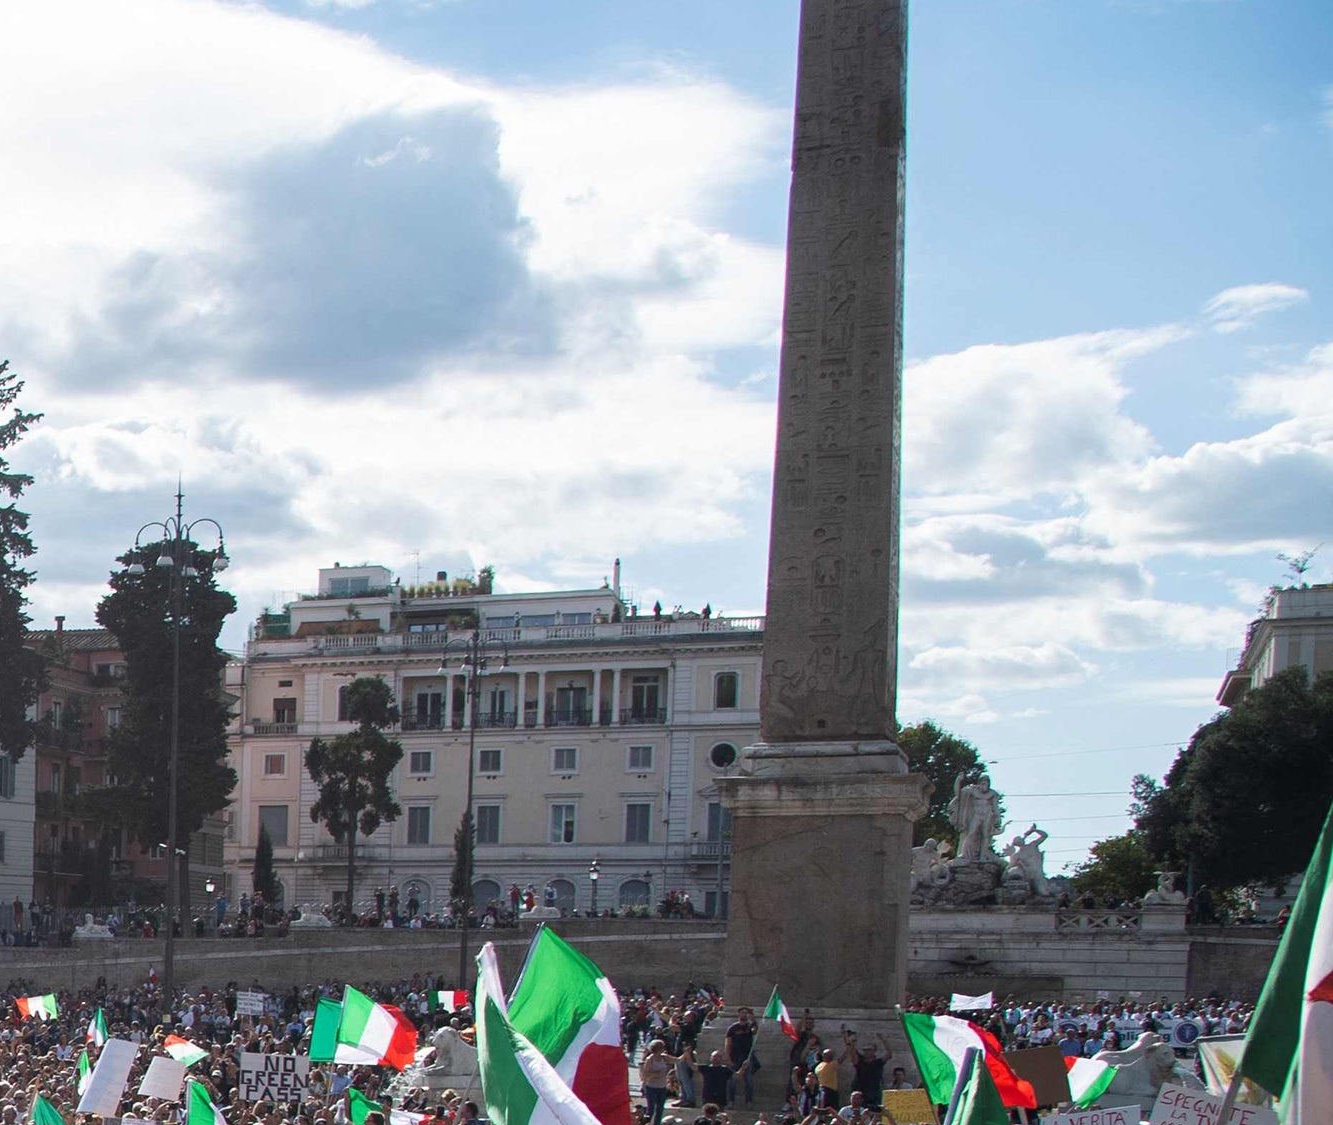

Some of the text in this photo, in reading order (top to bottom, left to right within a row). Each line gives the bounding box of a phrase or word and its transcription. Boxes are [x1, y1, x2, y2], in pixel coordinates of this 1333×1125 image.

[264, 1055, 296, 1072] NO
[241, 1070, 309, 1088] GREEN
[246, 1085, 301, 1102] PASS
[1171, 1109, 1187, 1122] LA
